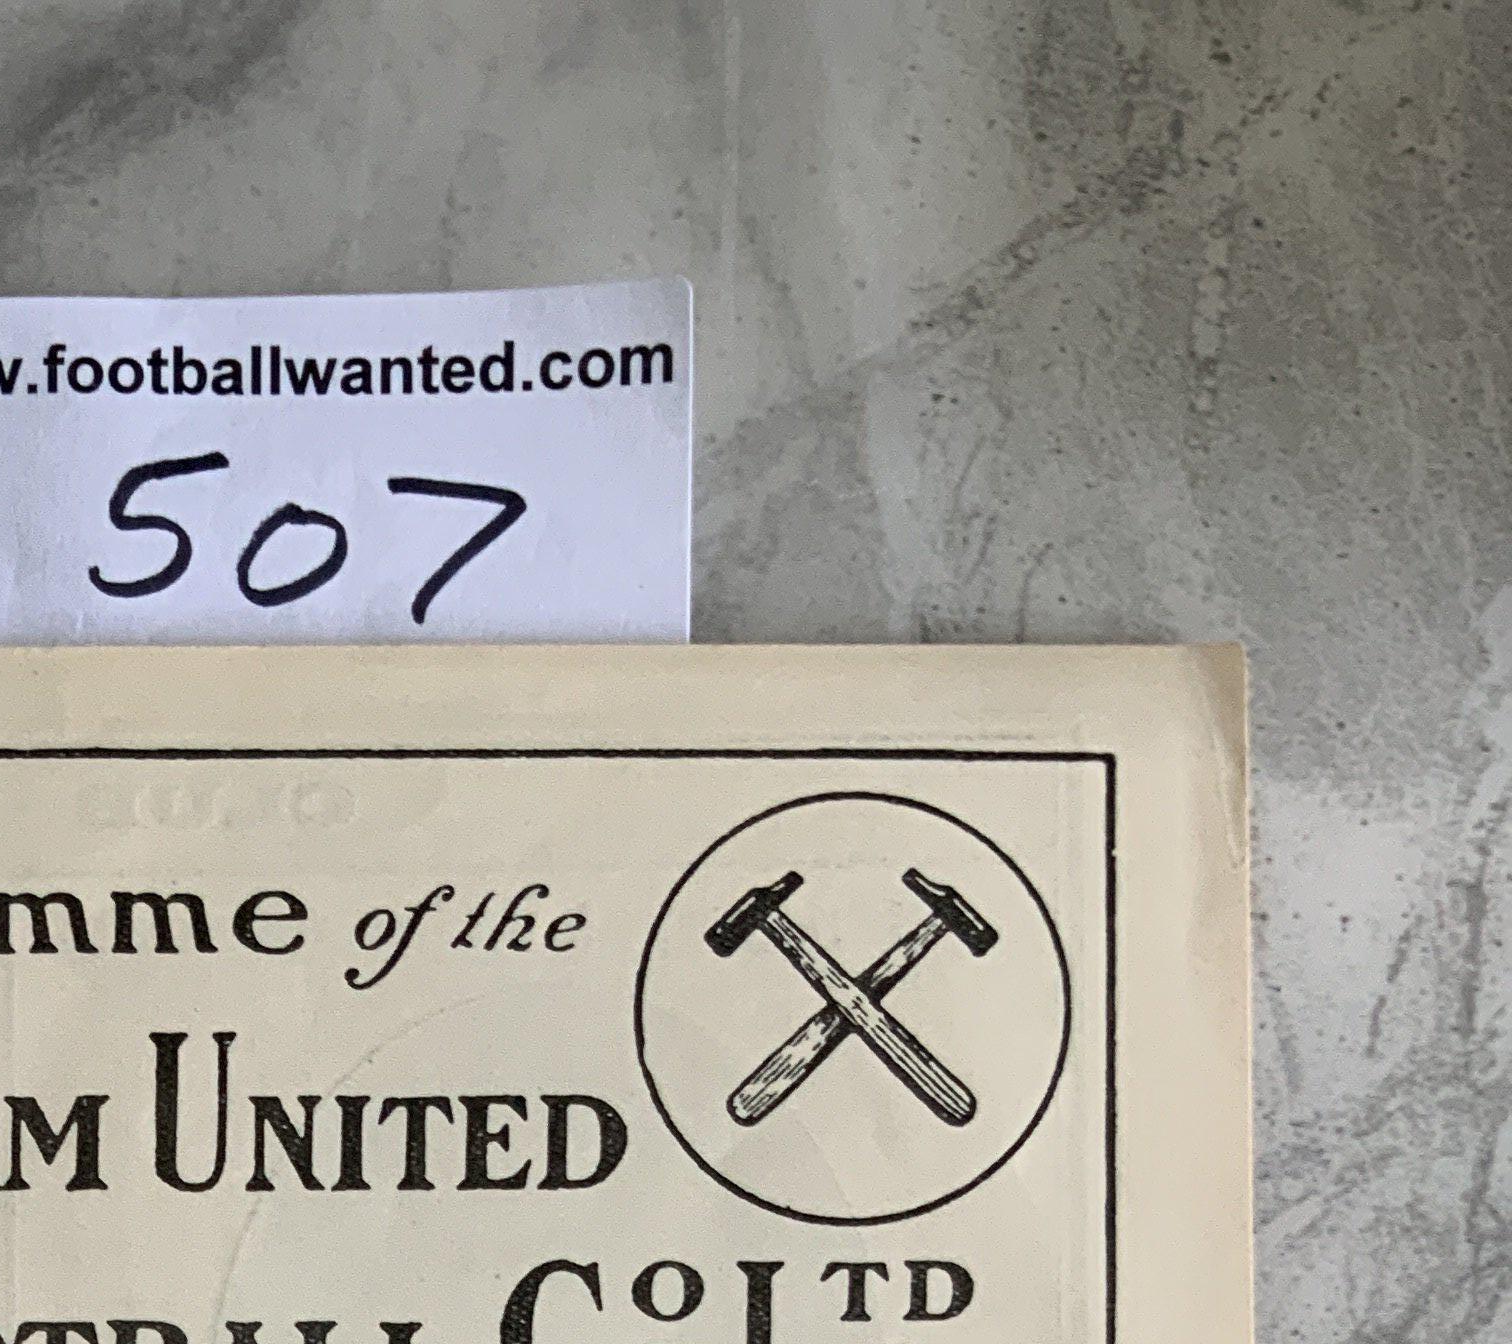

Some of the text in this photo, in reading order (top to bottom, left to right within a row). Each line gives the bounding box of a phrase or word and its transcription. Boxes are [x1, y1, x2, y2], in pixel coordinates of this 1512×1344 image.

[88, 451, 528, 626] 507
[344, 884, 456, 991] of
[450, 883, 587, 953] the
[148, 1030, 629, 1193] UNITED
